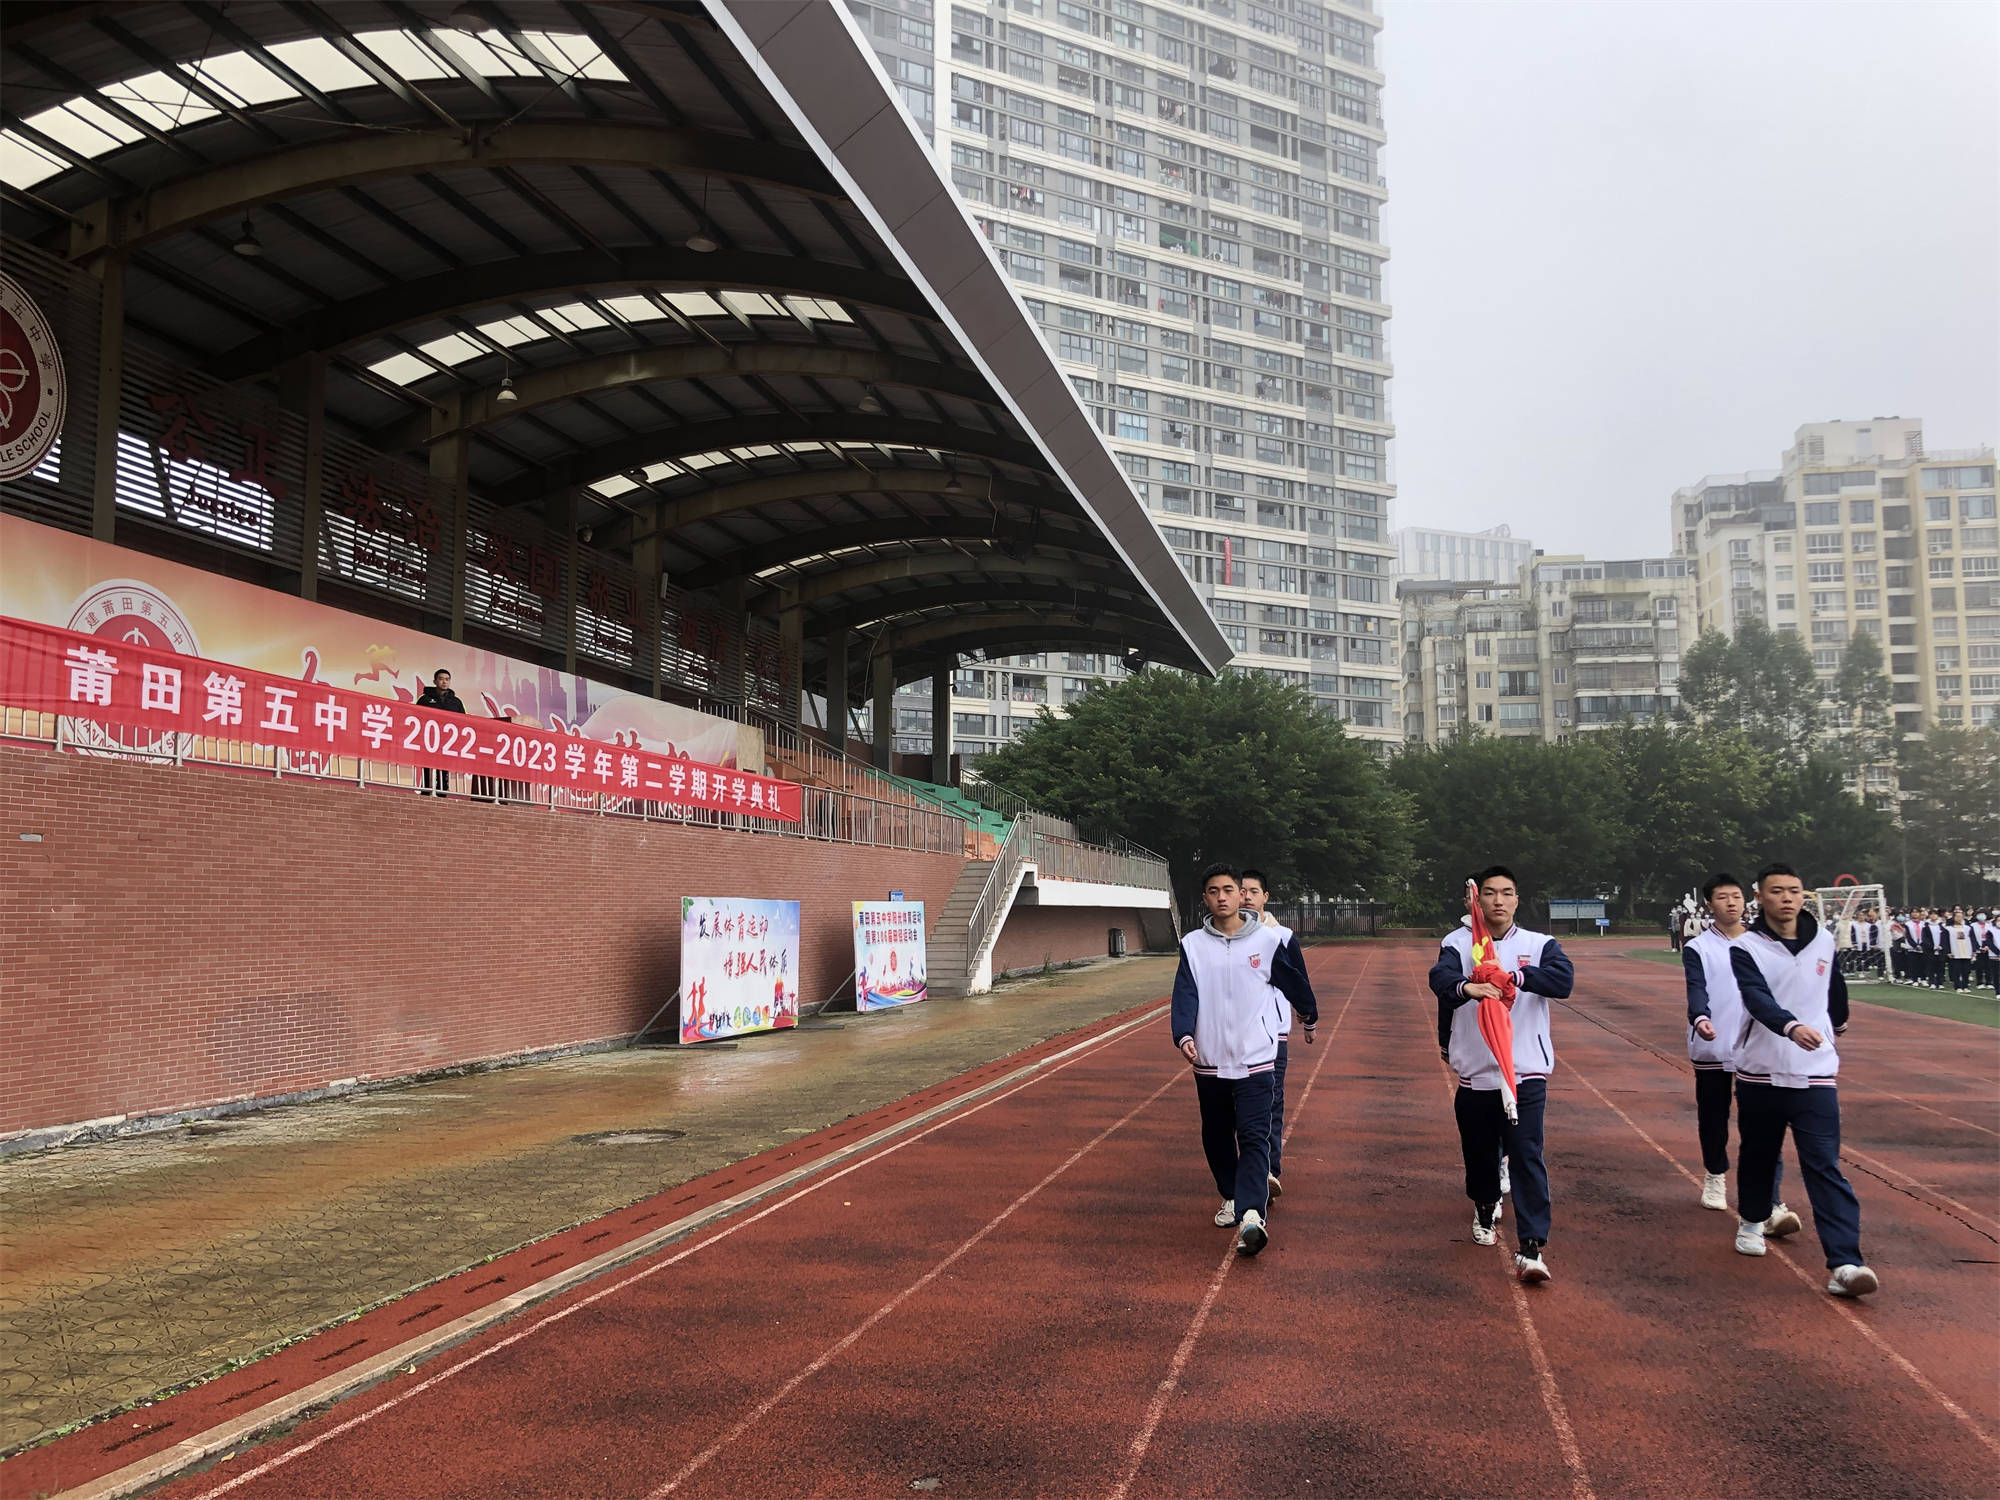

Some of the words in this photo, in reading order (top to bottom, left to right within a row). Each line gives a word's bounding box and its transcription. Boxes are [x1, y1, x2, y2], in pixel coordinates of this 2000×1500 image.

[15, 410, 51, 456] SCHOOL
[342, 472, 441, 553] 法治
[74, 597, 189, 655] 建莆田第五中
[64, 645, 781, 812] 莆田第五中学2022-2023学年第二学期开学典礼
